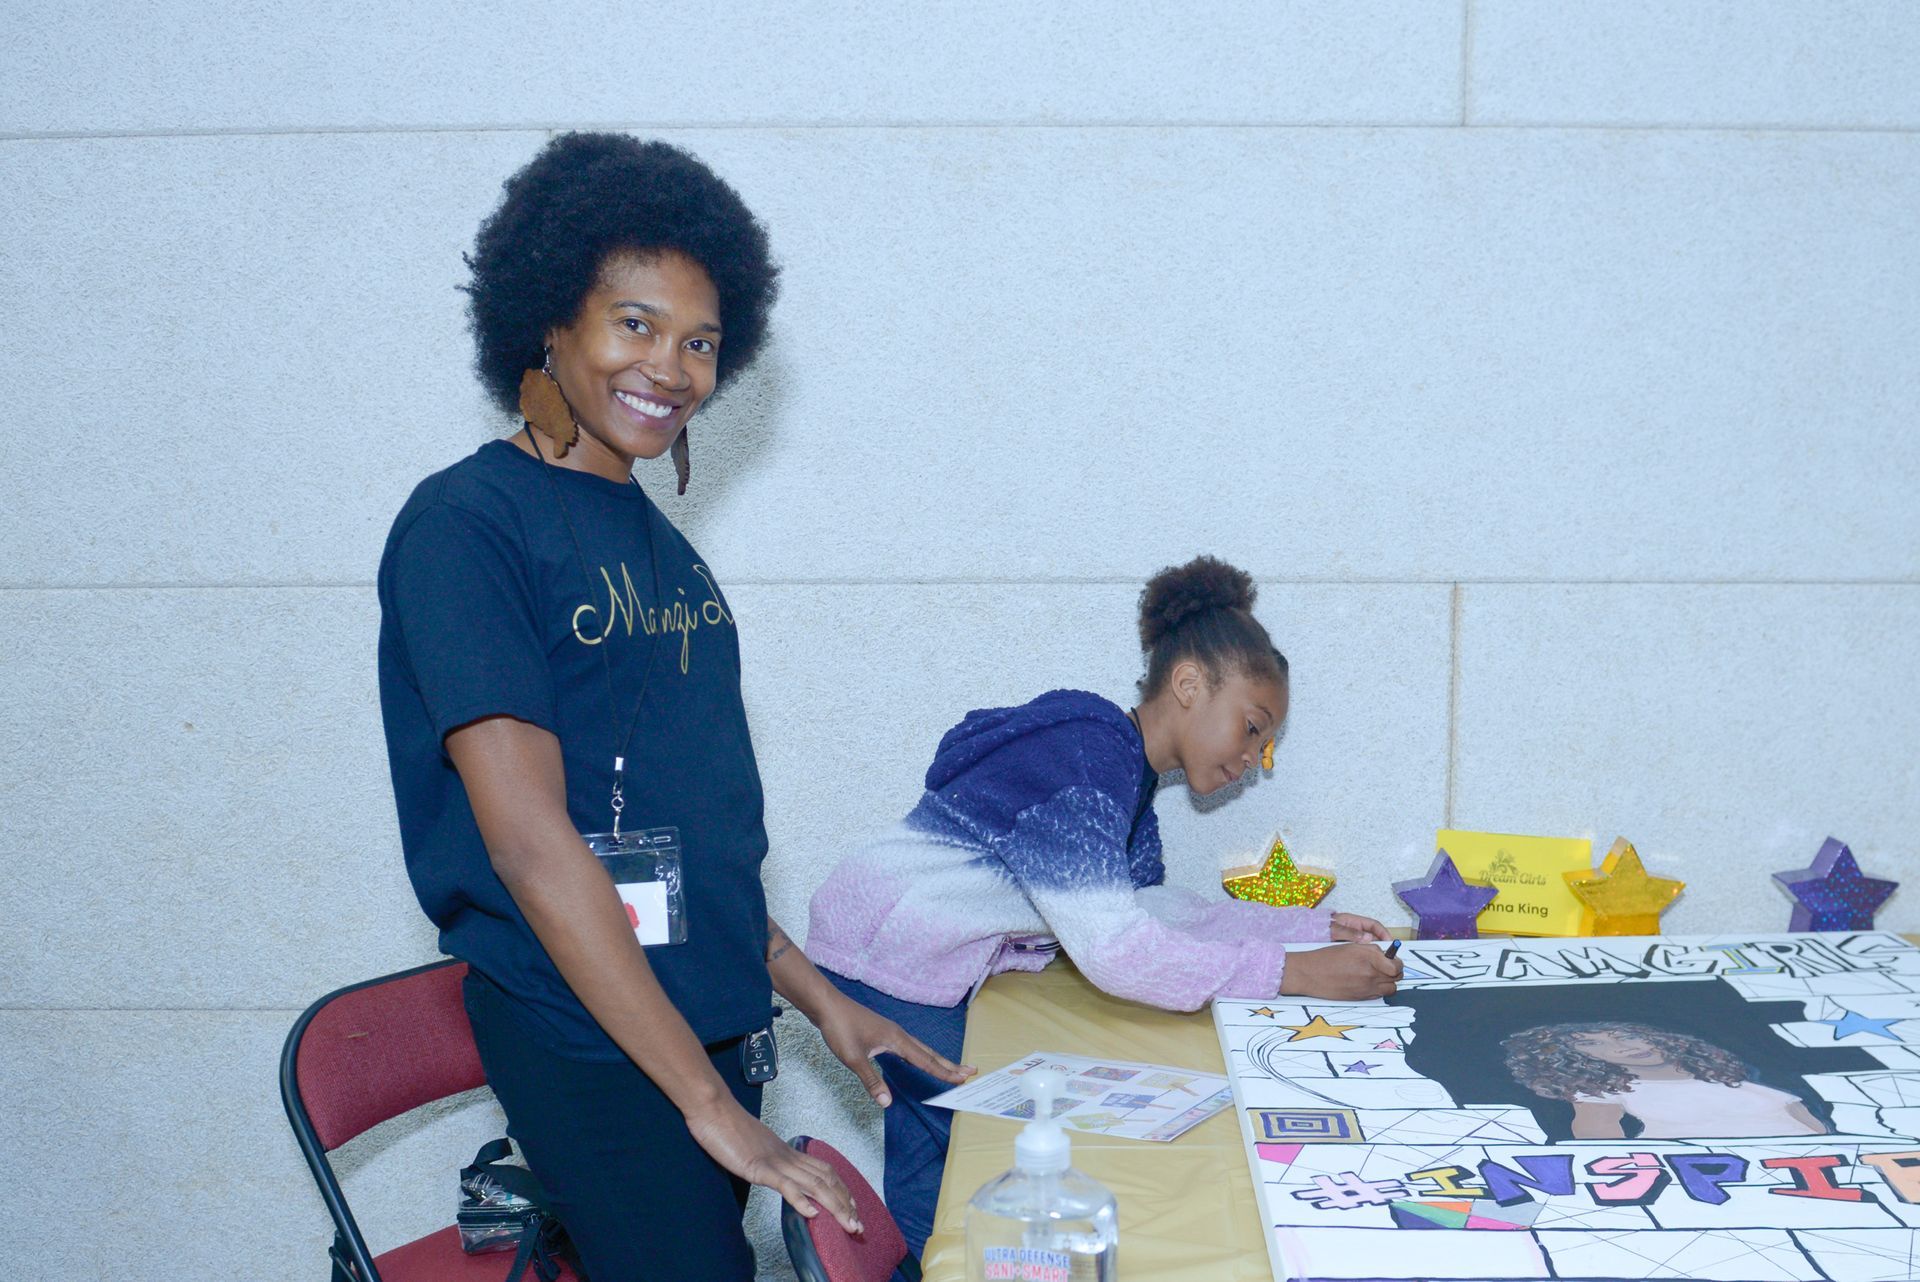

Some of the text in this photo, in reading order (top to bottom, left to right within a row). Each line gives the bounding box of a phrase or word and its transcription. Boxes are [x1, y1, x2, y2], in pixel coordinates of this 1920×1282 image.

[1479, 870, 1546, 886] Dream Girls
[1518, 903, 1549, 918] King
[1402, 938, 1916, 981] EAMGIRLS
[984, 1247, 1070, 1269] ULTRA DEFENSE
